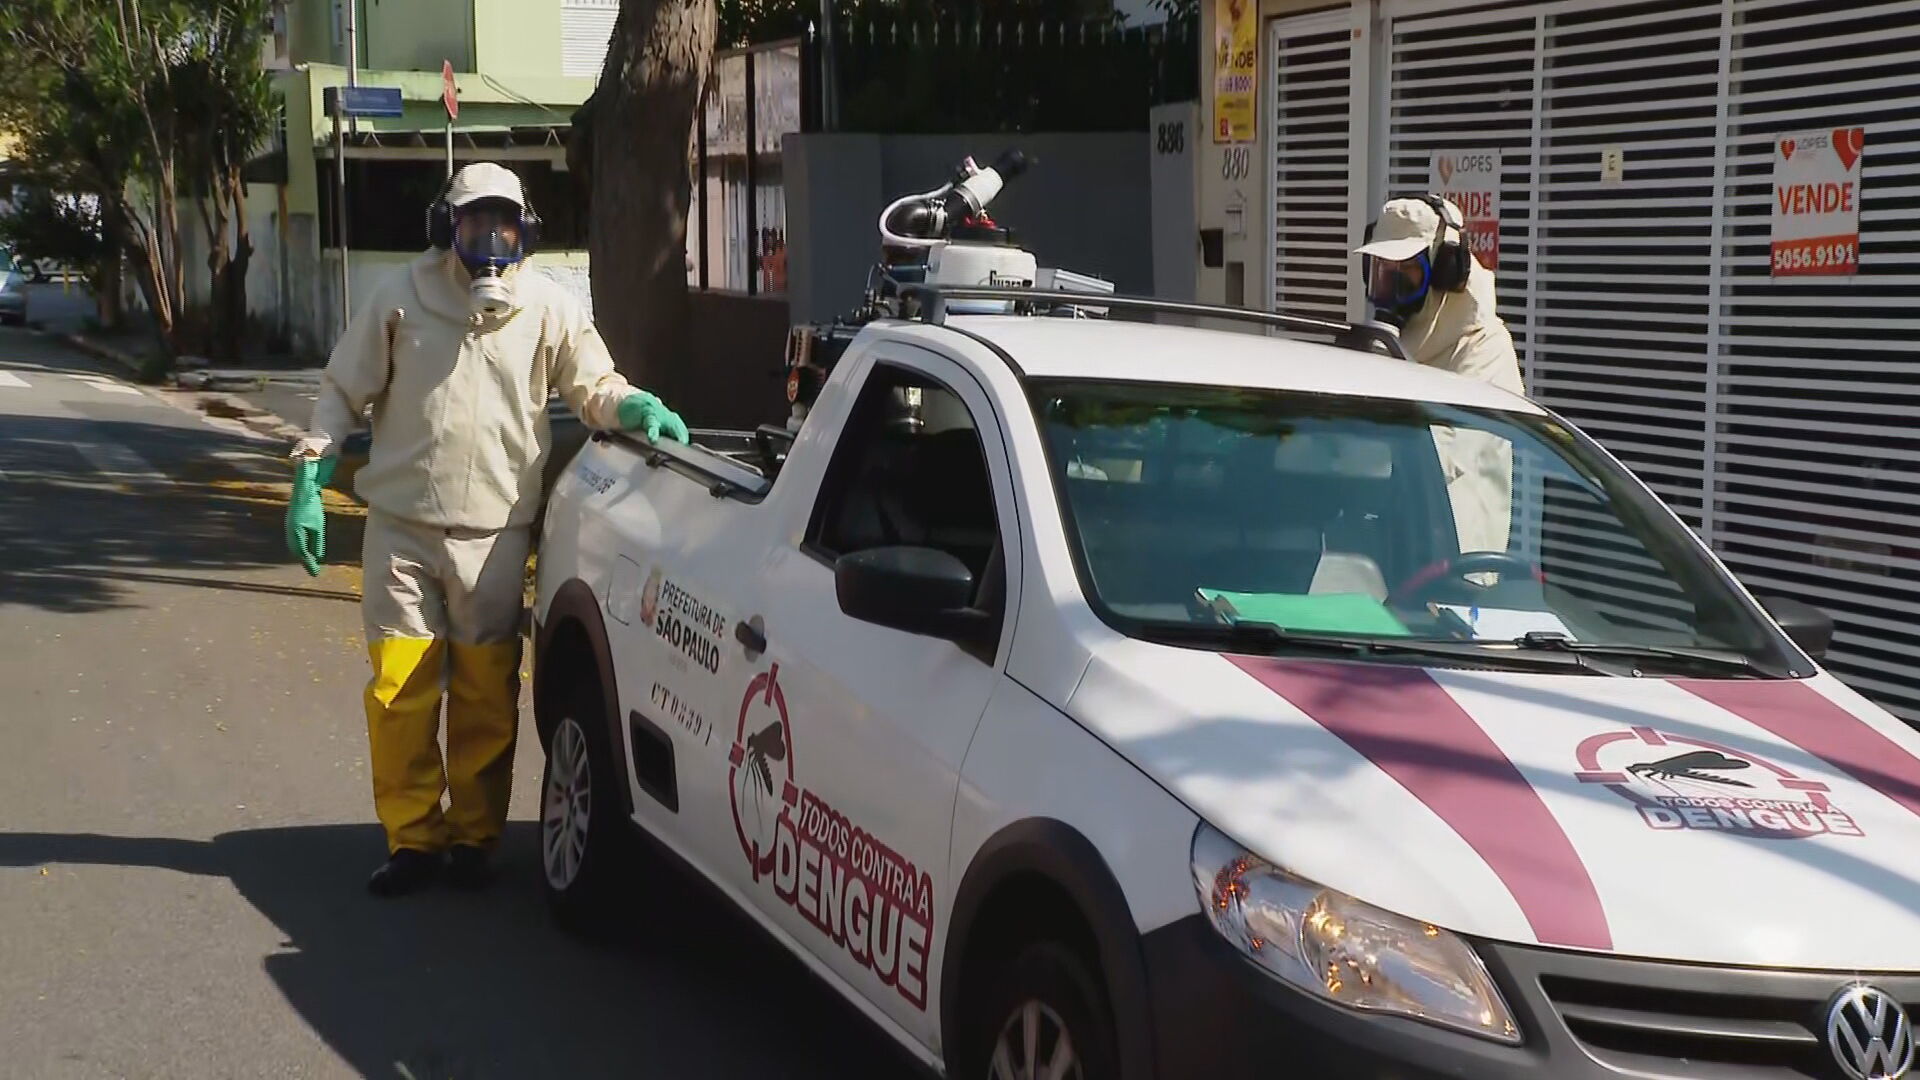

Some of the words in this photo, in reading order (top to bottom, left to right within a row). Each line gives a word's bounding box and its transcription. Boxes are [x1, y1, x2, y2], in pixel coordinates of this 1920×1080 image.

[1222, 147, 1250, 180] 880
[1455, 154, 1493, 173] LOPES
[1443, 191, 1493, 217] NDE
[1778, 182, 1854, 215] VENDE
[1773, 243, 1856, 270] 5056.9191
[661, 579, 713, 630] PREFEITURA
[712, 612, 726, 639] DE
[656, 606, 682, 648] SÃO
[682, 625, 720, 676] PAULO
[1642, 806, 1864, 836] DENGUE
[1660, 796, 1736, 808] TODOS
[1736, 798, 1822, 813] CONTRA
[800, 798, 849, 858] TODOS
[851, 835, 914, 910] CONTRA
[917, 883, 929, 920] A
[774, 819, 928, 1002] DENGUE
